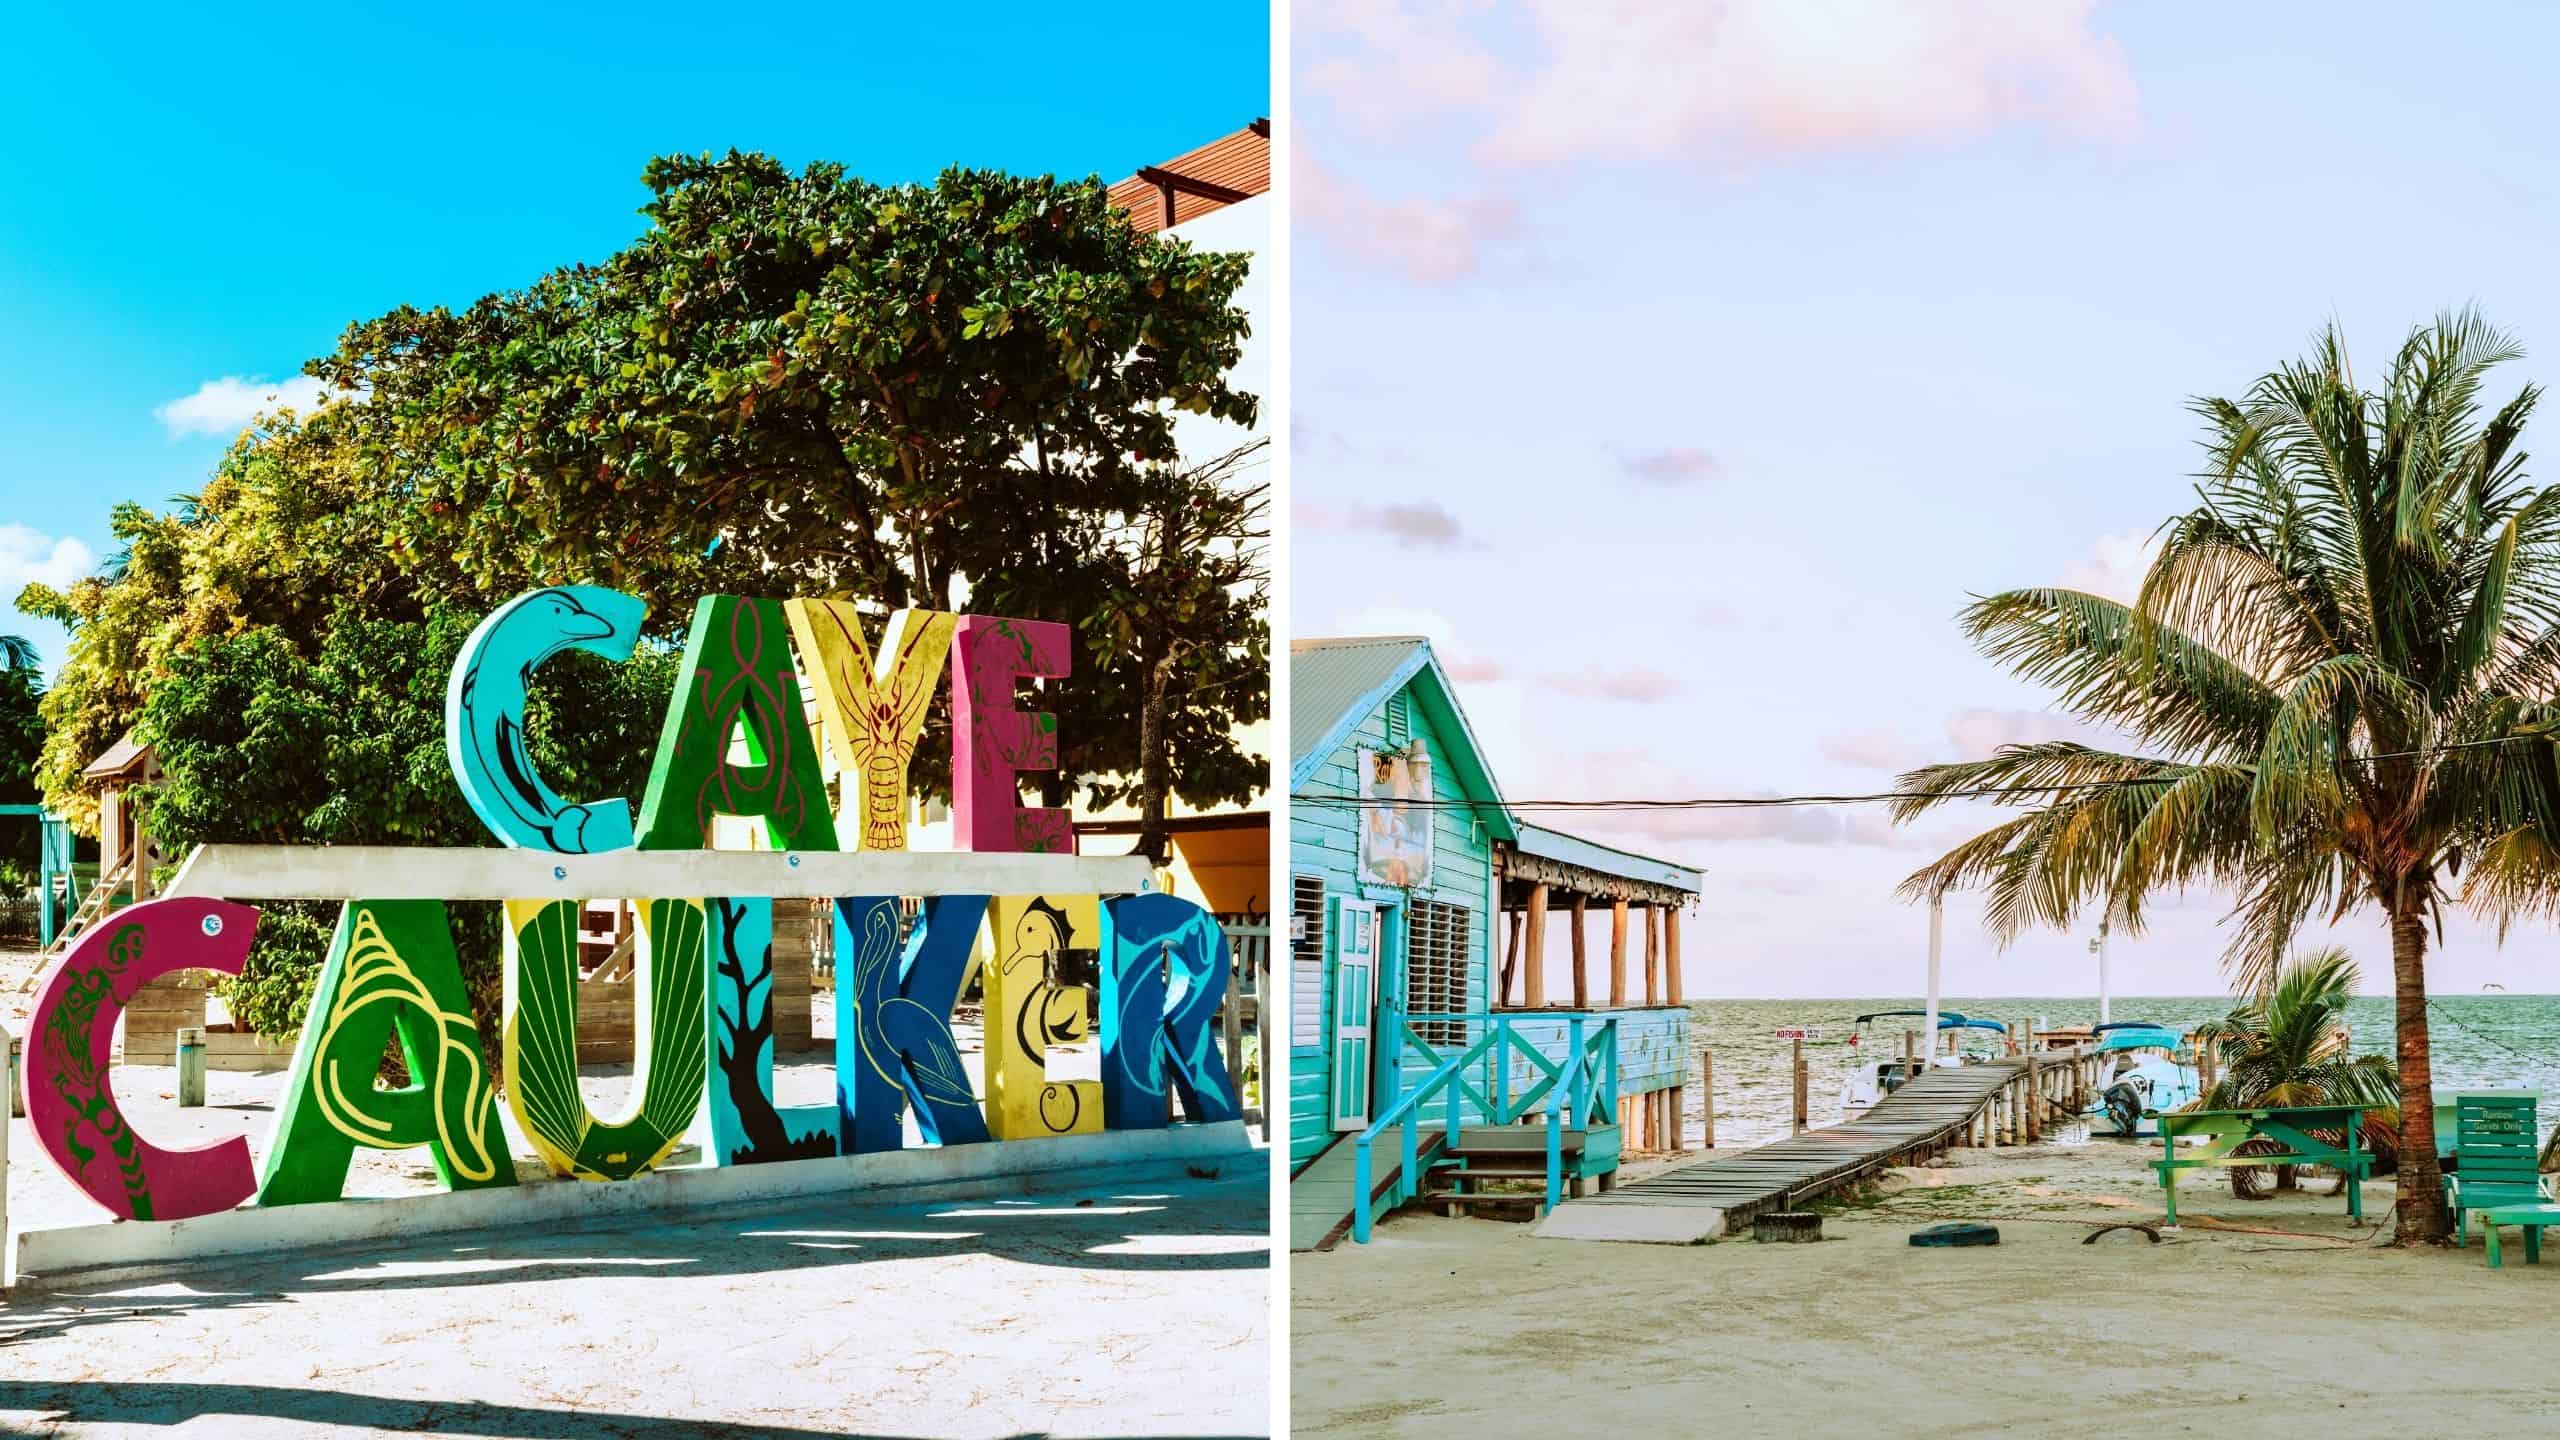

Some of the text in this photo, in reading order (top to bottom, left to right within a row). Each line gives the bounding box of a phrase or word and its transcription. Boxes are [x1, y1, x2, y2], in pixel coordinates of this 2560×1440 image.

[445, 584, 1072, 855] CAYE
[20, 893, 1243, 1223] CAULKER
[1776, 1030, 1785, 1039] NO
